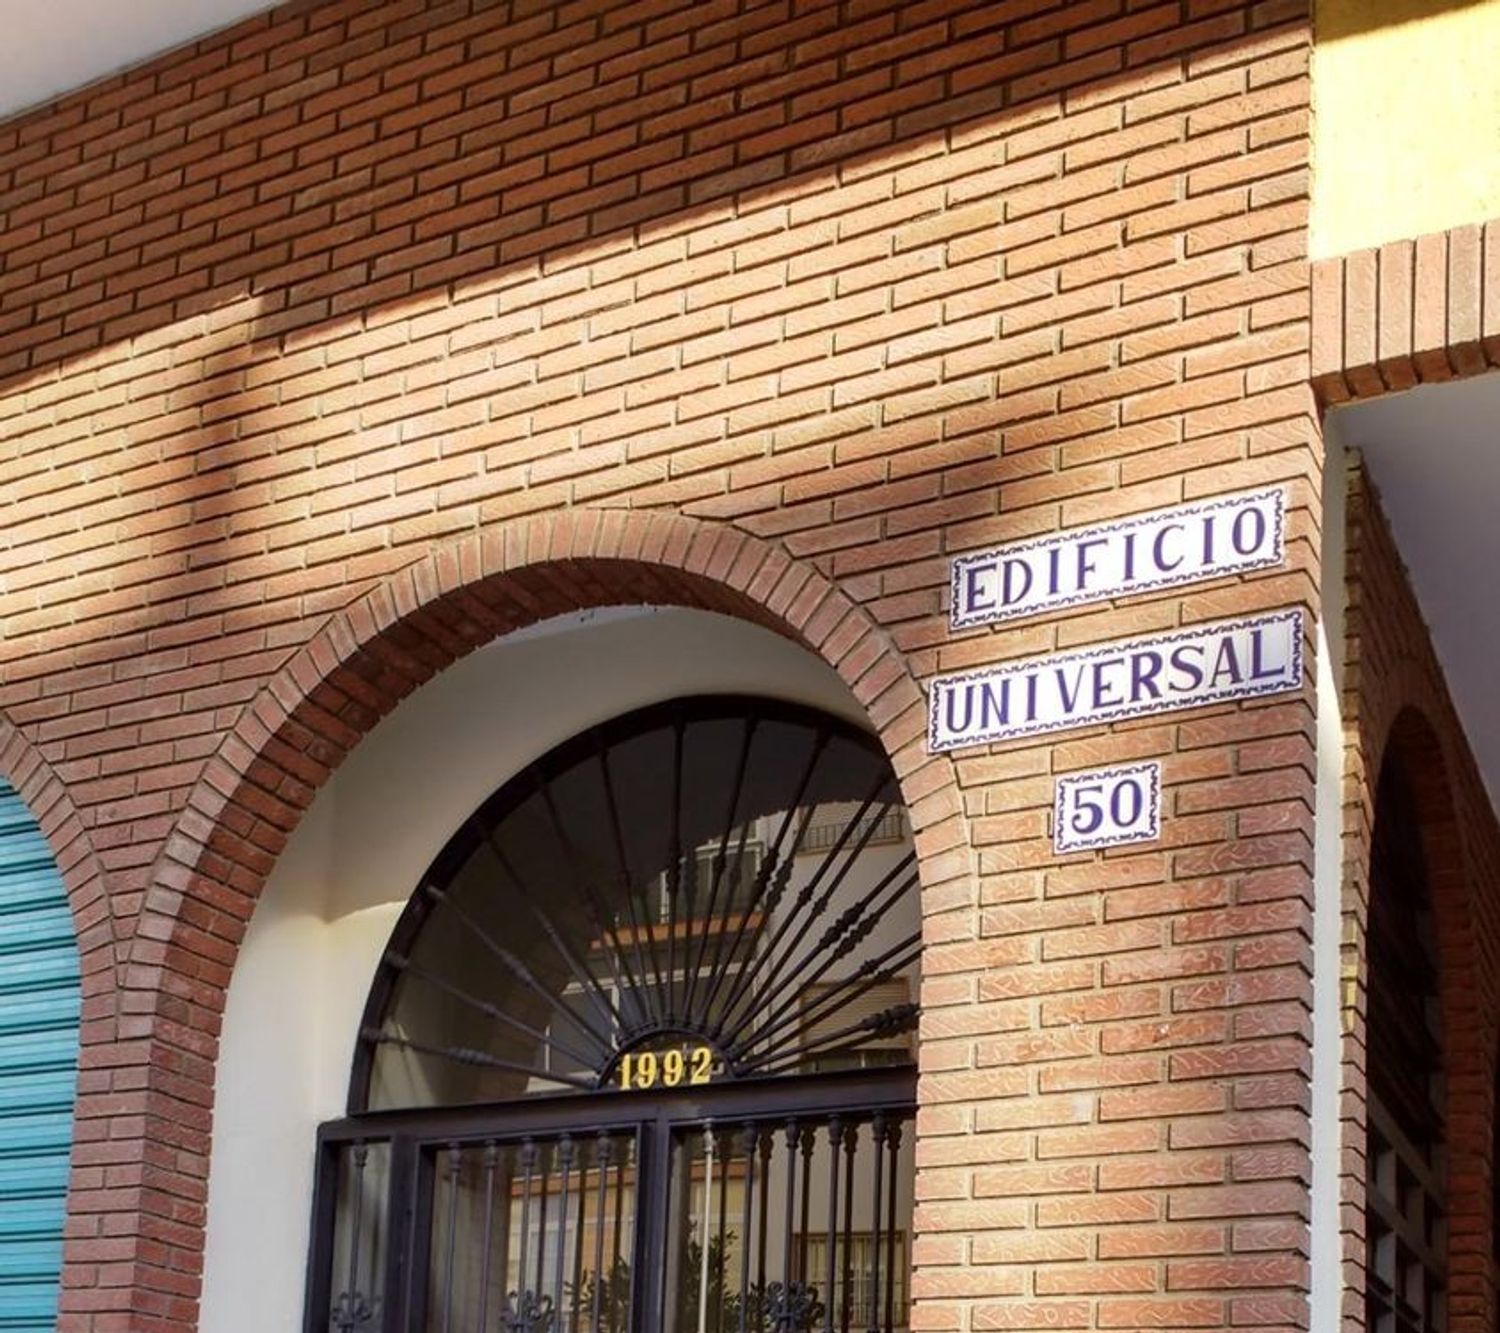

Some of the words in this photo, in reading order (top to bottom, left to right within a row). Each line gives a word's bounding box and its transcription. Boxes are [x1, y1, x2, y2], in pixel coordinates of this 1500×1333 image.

[965, 507, 1266, 612] EDIFICIO
[944, 631, 1285, 734] UNIVERSAL
[1071, 779, 1143, 834] 50
[620, 1047, 712, 1090] 1992
